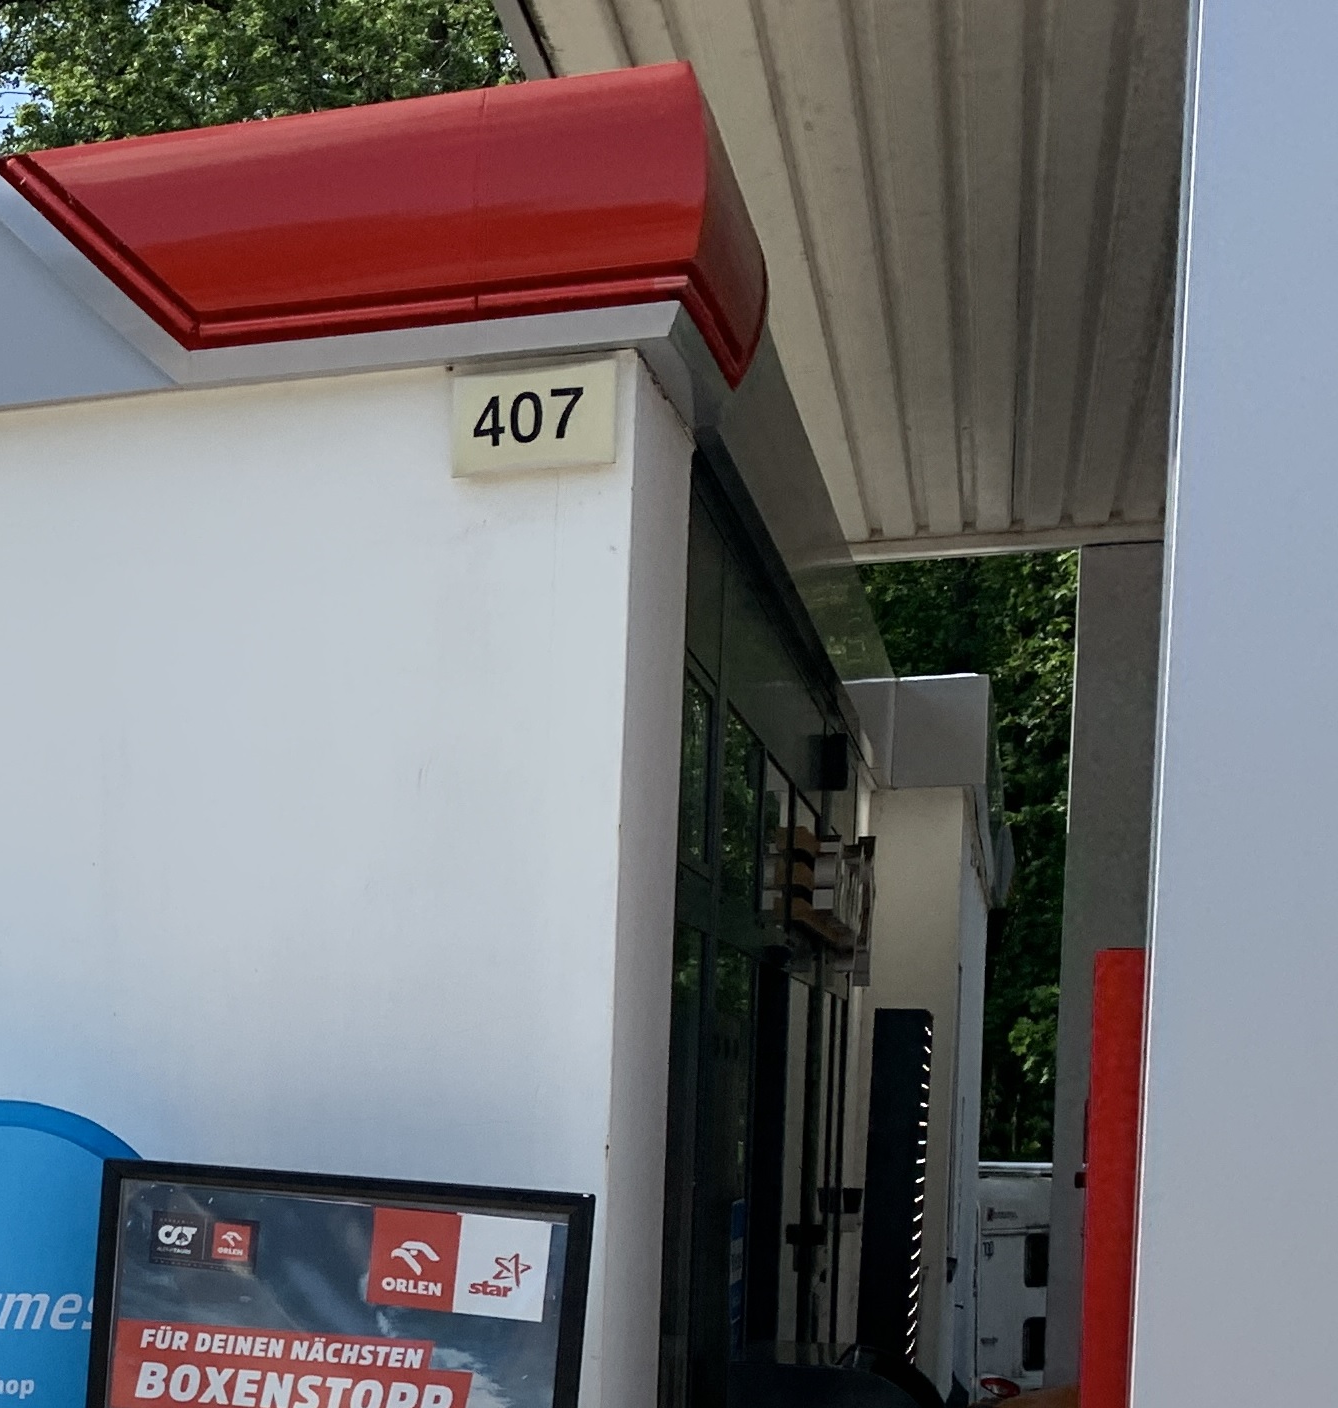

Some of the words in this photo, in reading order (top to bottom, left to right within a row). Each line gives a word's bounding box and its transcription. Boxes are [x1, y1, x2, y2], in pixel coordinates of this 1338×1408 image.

[473, 386, 584, 447] 407
[216, 1247, 244, 1256] ORLEN
[381, 1276, 442, 1298] ORLEN
[468, 1281, 512, 1298] star
[140, 1326, 189, 1351] FÜR
[195, 1333, 285, 1360] DEINEN
[290, 1337, 424, 1370] NÄCHSTEN
